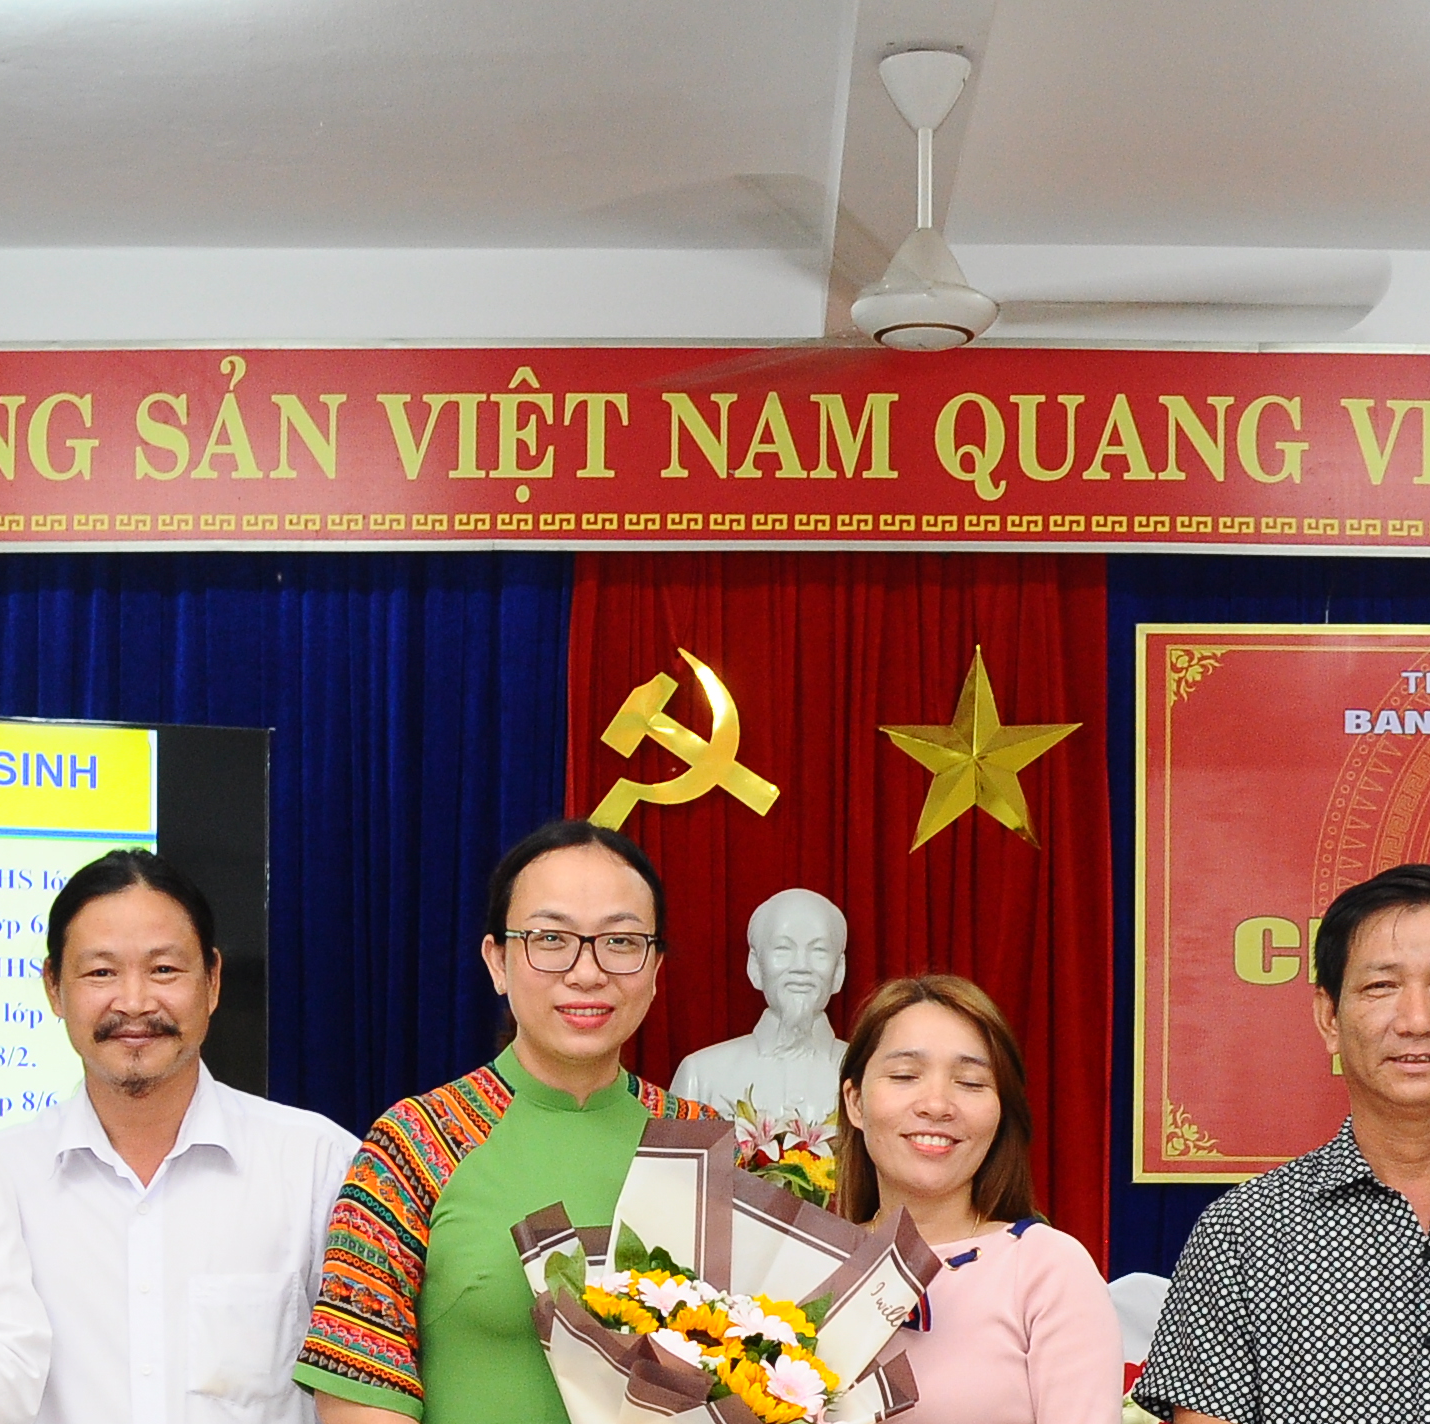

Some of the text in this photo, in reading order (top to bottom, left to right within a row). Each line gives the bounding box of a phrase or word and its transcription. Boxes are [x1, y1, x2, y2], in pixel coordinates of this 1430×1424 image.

[134, 355, 340, 481] SẢN
[377, 366, 629, 502] VIỆT
[660, 391, 899, 480] NAM
[934, 391, 1311, 501] QUANG
[43, 869, 68, 890] lớ
[4, 1002, 44, 1030] lớp
